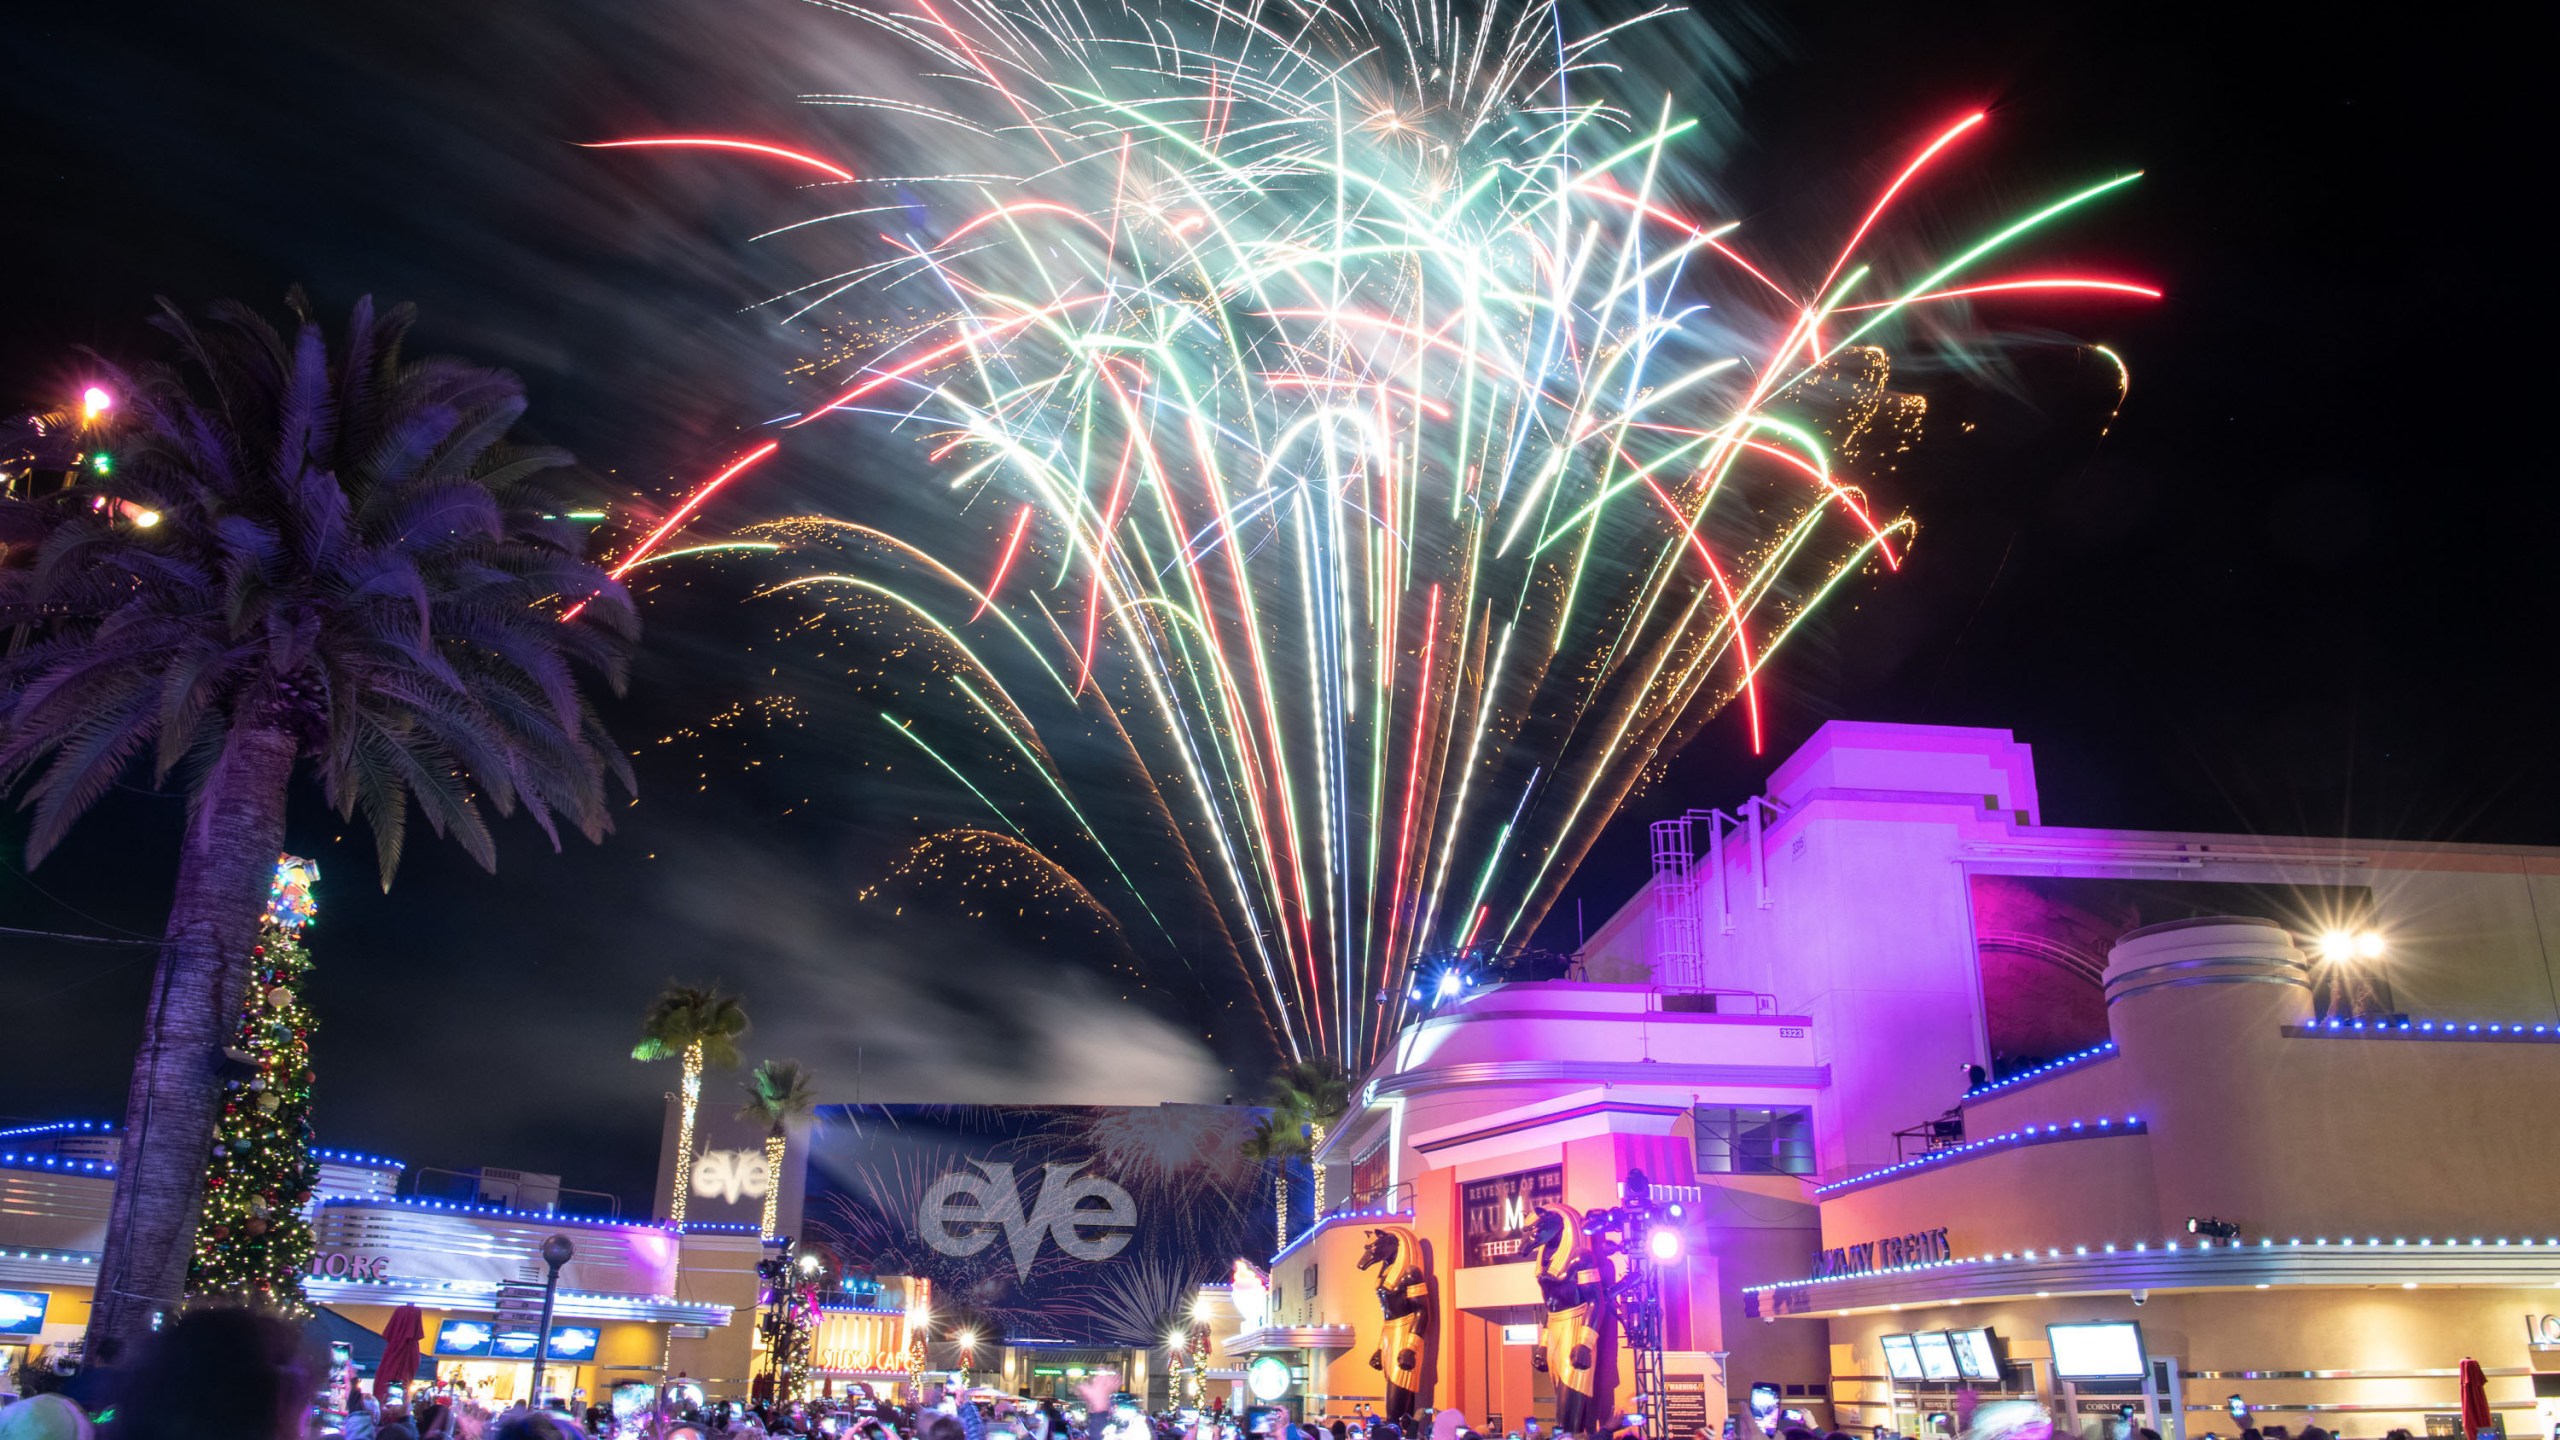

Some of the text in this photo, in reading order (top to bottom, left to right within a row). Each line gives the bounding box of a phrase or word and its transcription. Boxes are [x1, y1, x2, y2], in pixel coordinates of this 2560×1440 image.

[1469, 1172, 1561, 1200] REVENGE OF THE
[1484, 1239, 1510, 1257] THE
[1877, 1227, 1950, 1270] TREATS
[312, 1251, 391, 1281] TORE
[822, 1349, 872, 1370] STUDIO
[2085, 1403, 2110, 1411] CORN
